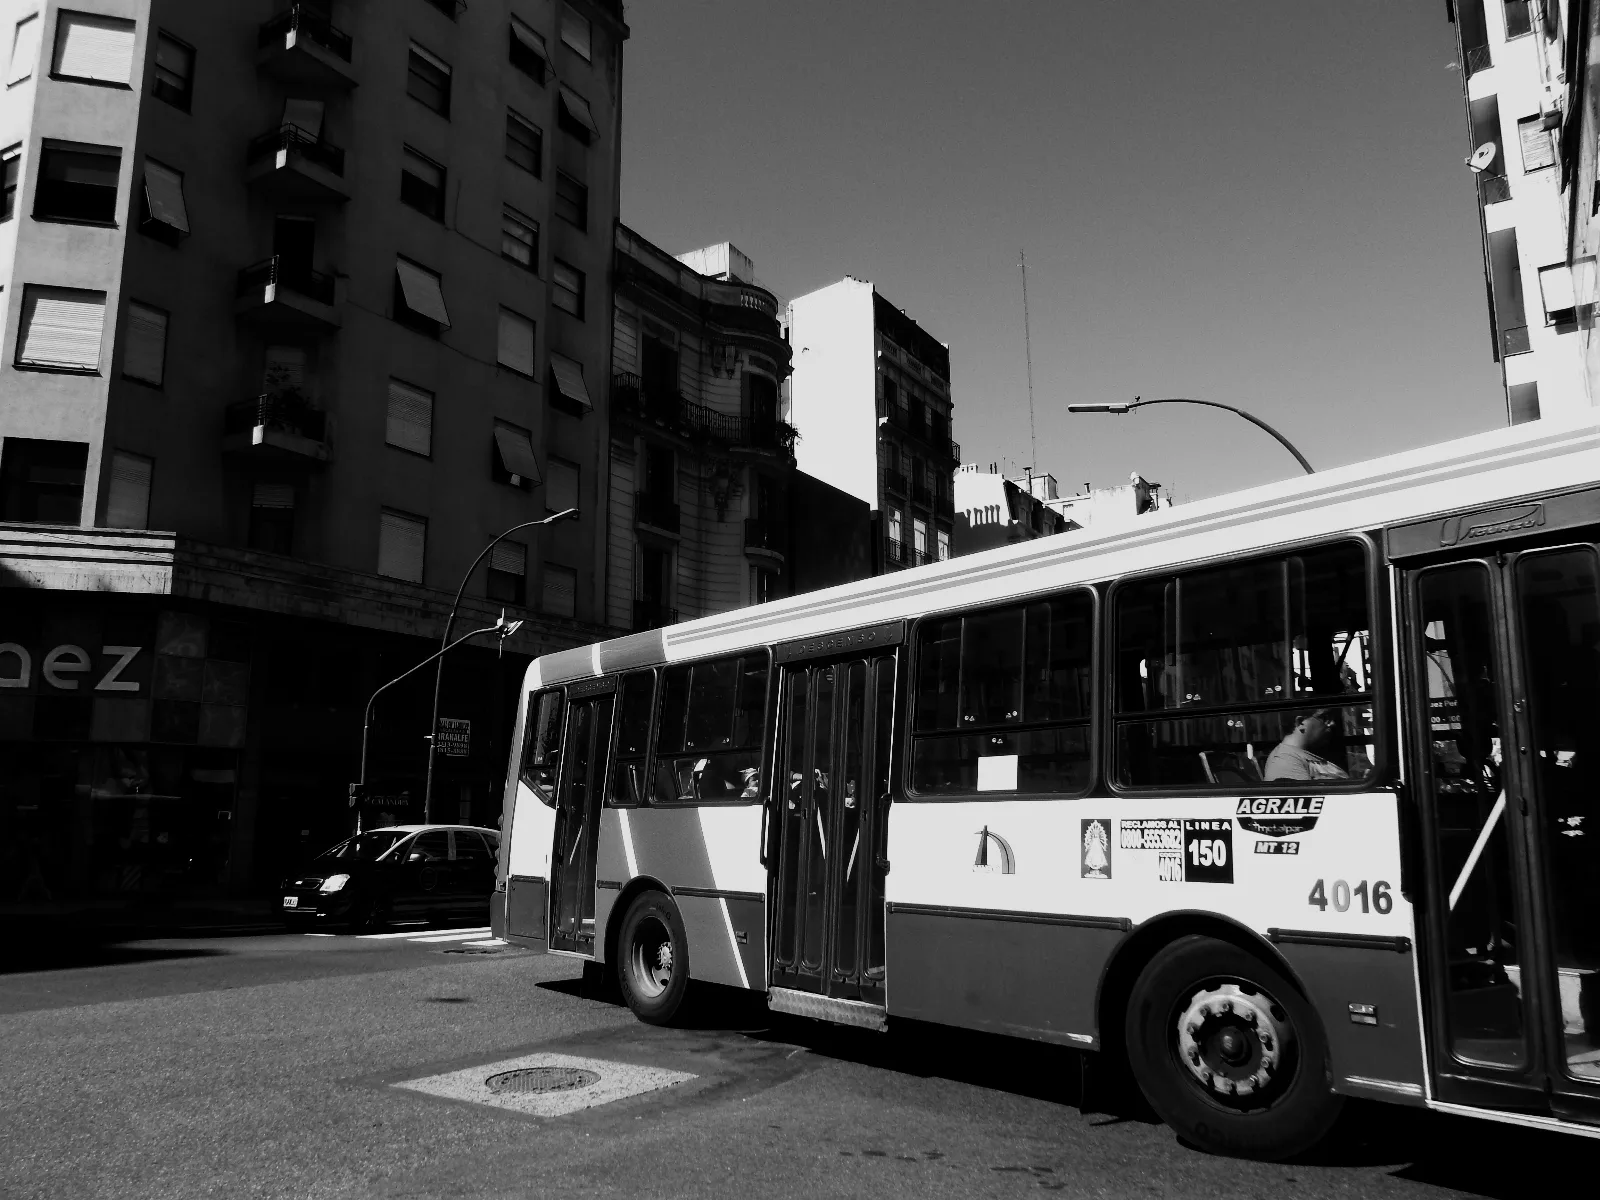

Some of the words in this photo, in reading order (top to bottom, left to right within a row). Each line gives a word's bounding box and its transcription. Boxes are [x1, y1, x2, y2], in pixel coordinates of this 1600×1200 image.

[1237, 798, 1324, 814] AGRALE
[1121, 820, 1167, 829] RECLAMOS
[1168, 820, 1181, 829] AL
[1185, 821, 1232, 831] LINEA
[1188, 839, 1227, 867] 150
[1256, 842, 1278, 853] MT
[1281, 842, 1298, 854] 12
[1159, 857, 1182, 881] 4016
[1308, 878, 1393, 915] 4016
